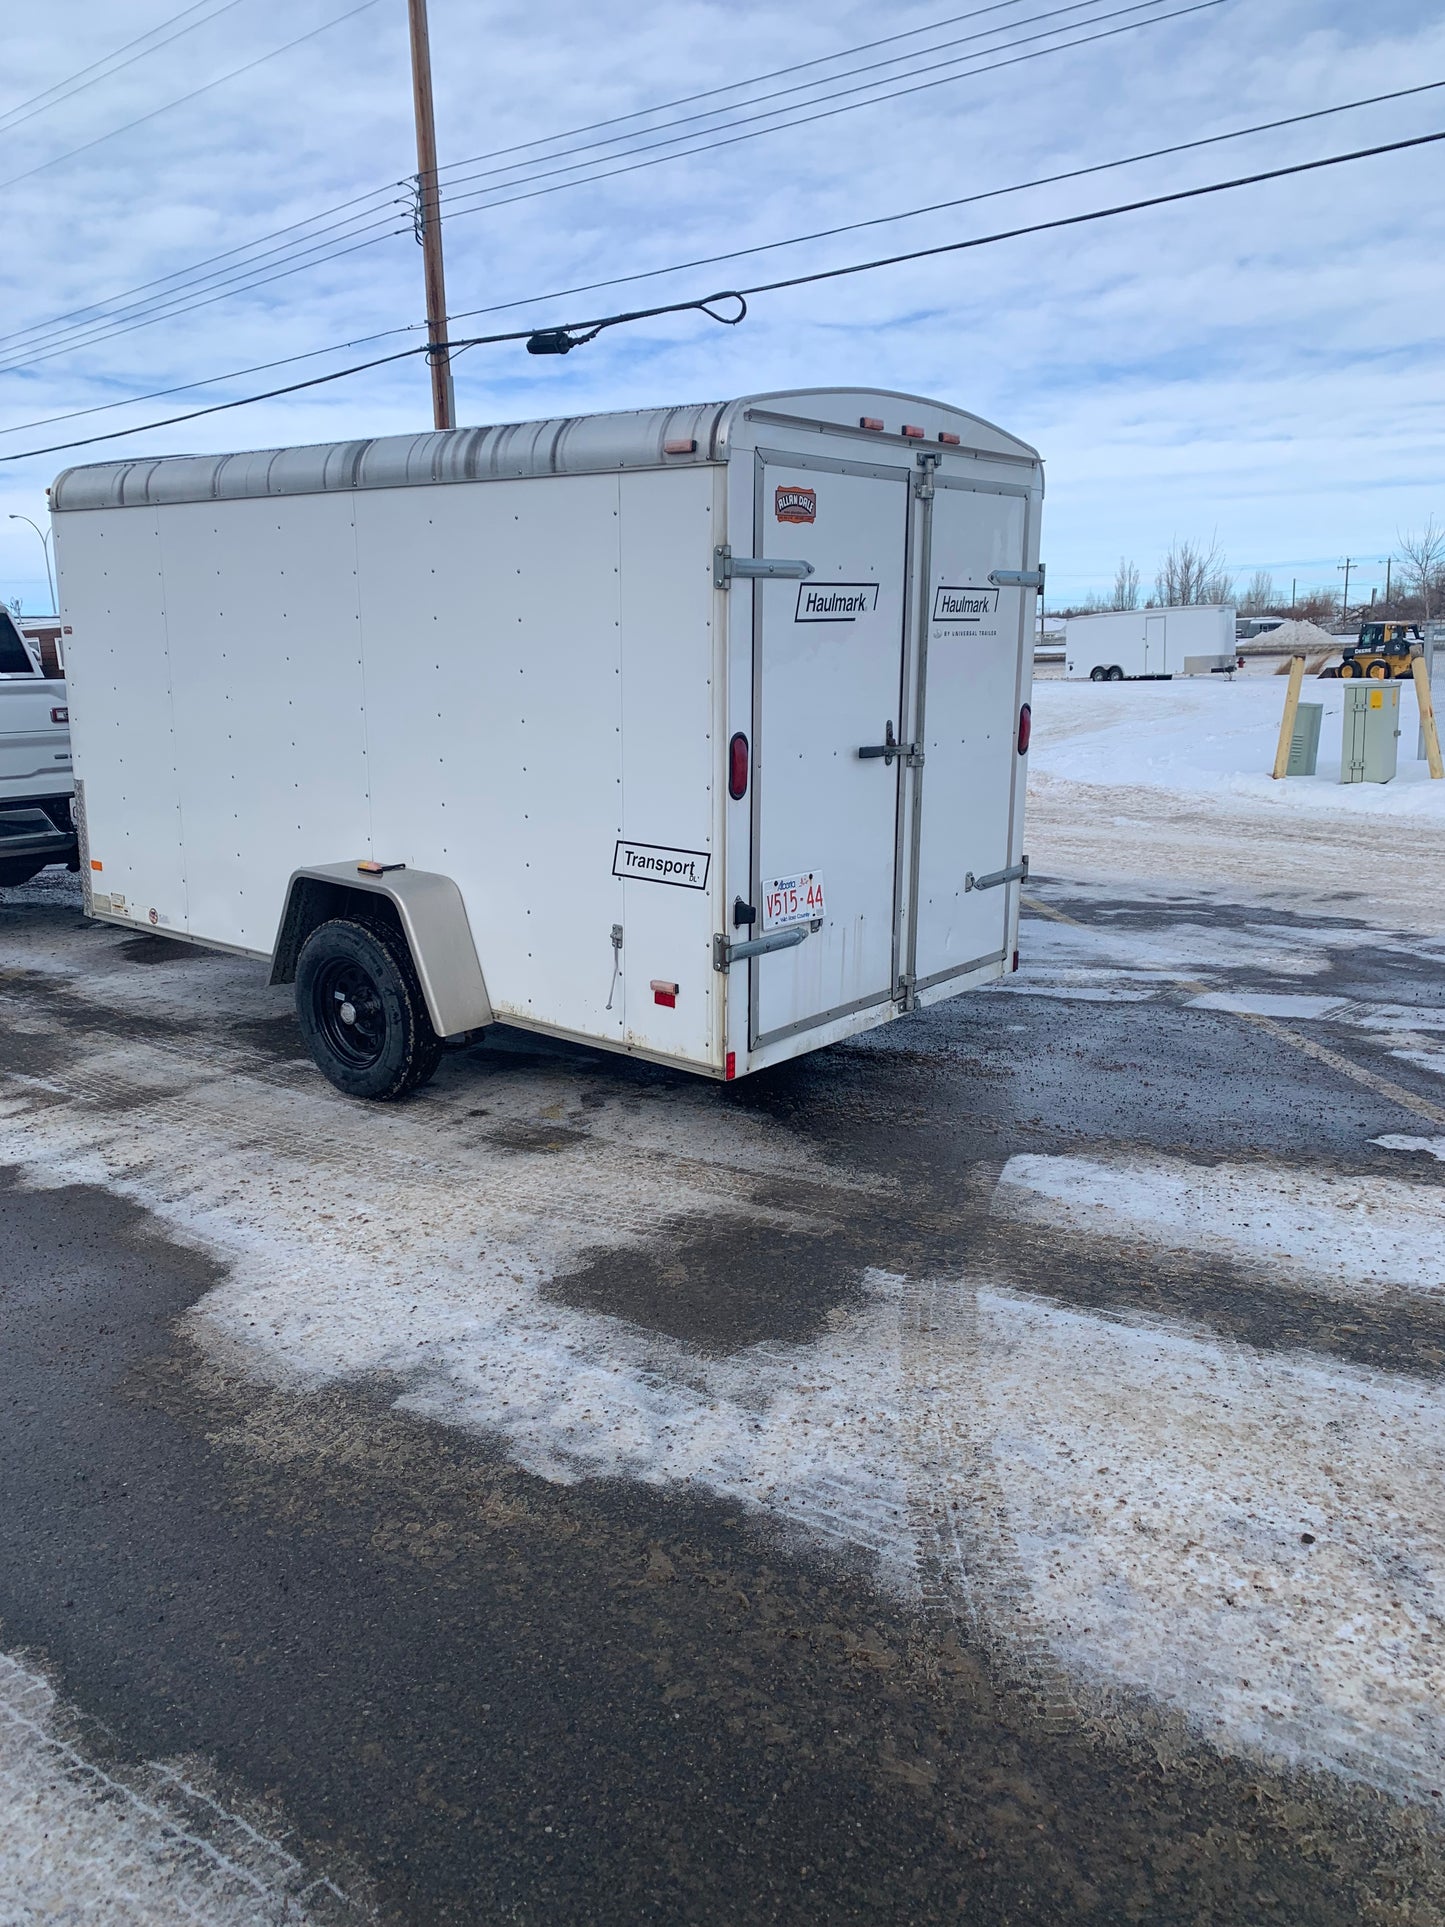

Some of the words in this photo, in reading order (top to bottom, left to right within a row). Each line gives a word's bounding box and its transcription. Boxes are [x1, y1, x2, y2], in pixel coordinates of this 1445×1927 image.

[778, 494, 799, 510] ALLAN
[799, 496, 814, 513] DALE
[806, 593, 866, 612] Haulmark
[941, 595, 989, 613] Haulmark
[625, 850, 696, 876] Transport
